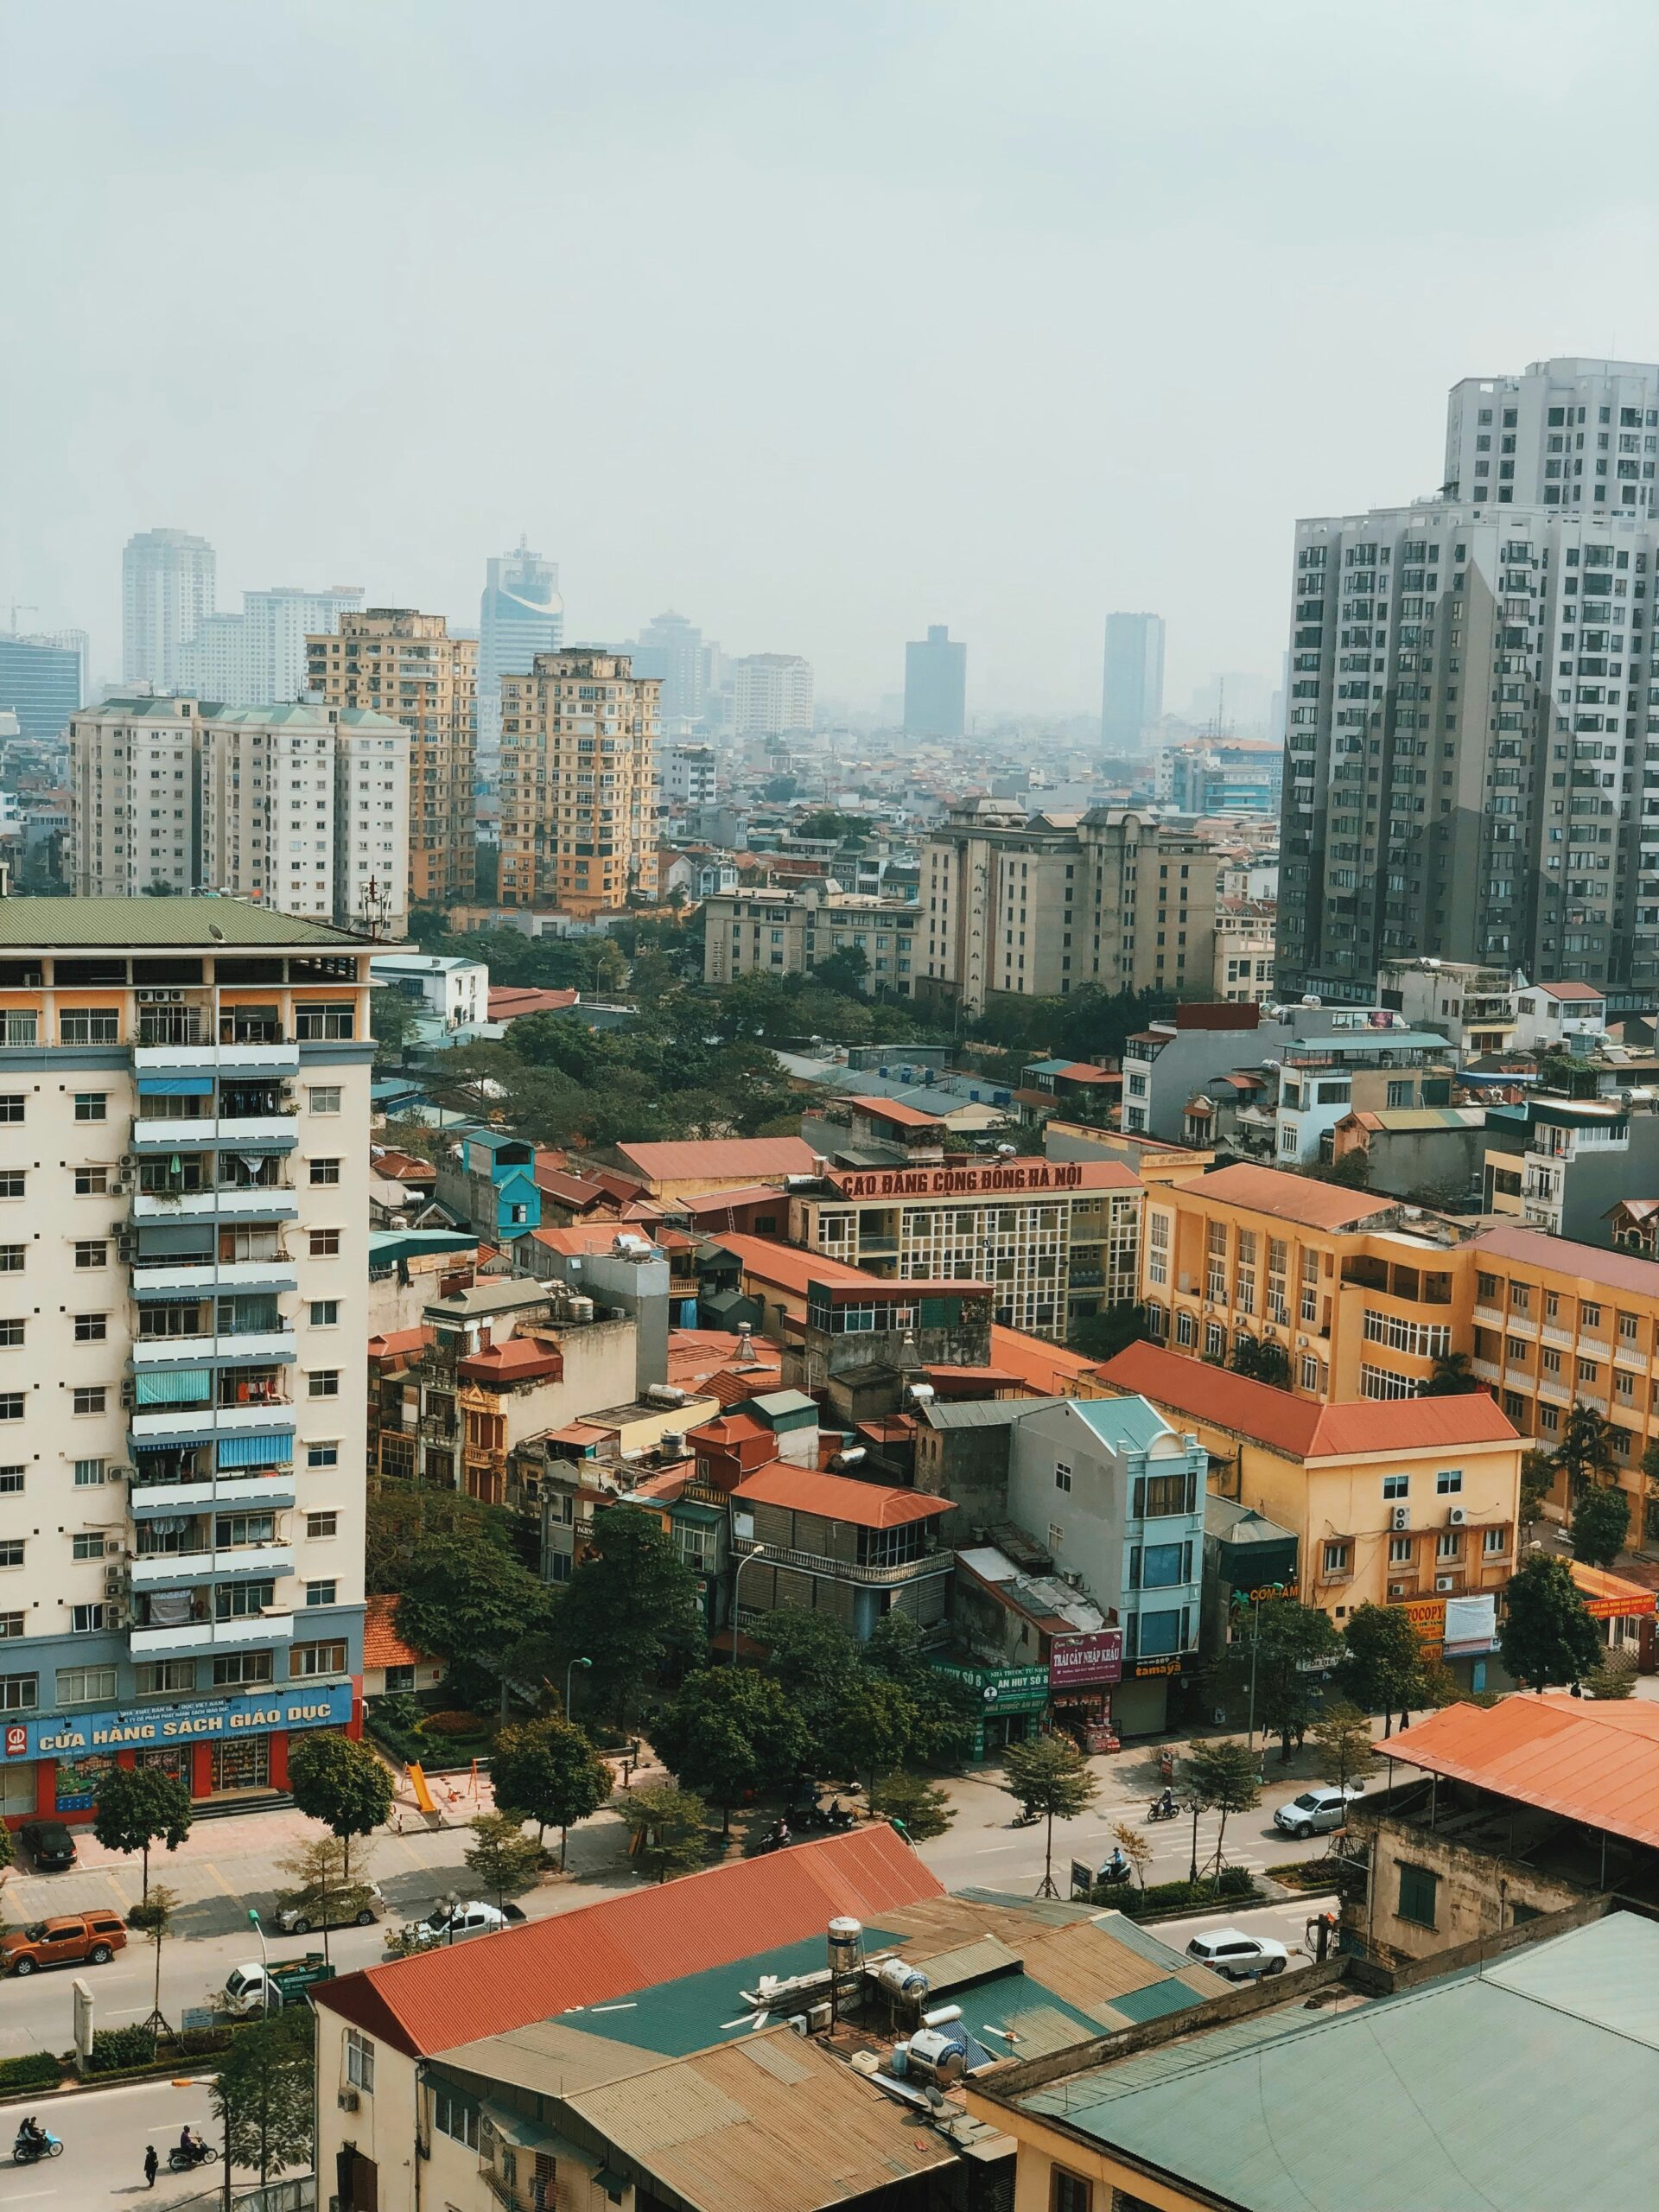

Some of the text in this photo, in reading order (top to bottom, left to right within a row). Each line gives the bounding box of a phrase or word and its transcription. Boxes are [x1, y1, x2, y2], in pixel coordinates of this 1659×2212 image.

[842, 1175, 876, 1196] CAO
[1054, 1649, 1069, 1668] TRÁI
[1070, 1649, 1084, 1666] CÂY
[1084, 1647, 1101, 1666] NHẬP
[976, 1675, 982, 1688] 8
[998, 1679, 1010, 1688] AN
[1011, 1677, 1028, 1688] HUY
[1030, 1673, 1041, 1686] SỐ
[1043, 1675, 1049, 1684] 8
[40, 1703, 332, 1751] CỬA HÀNG SÁCH GIÁO DỤC
